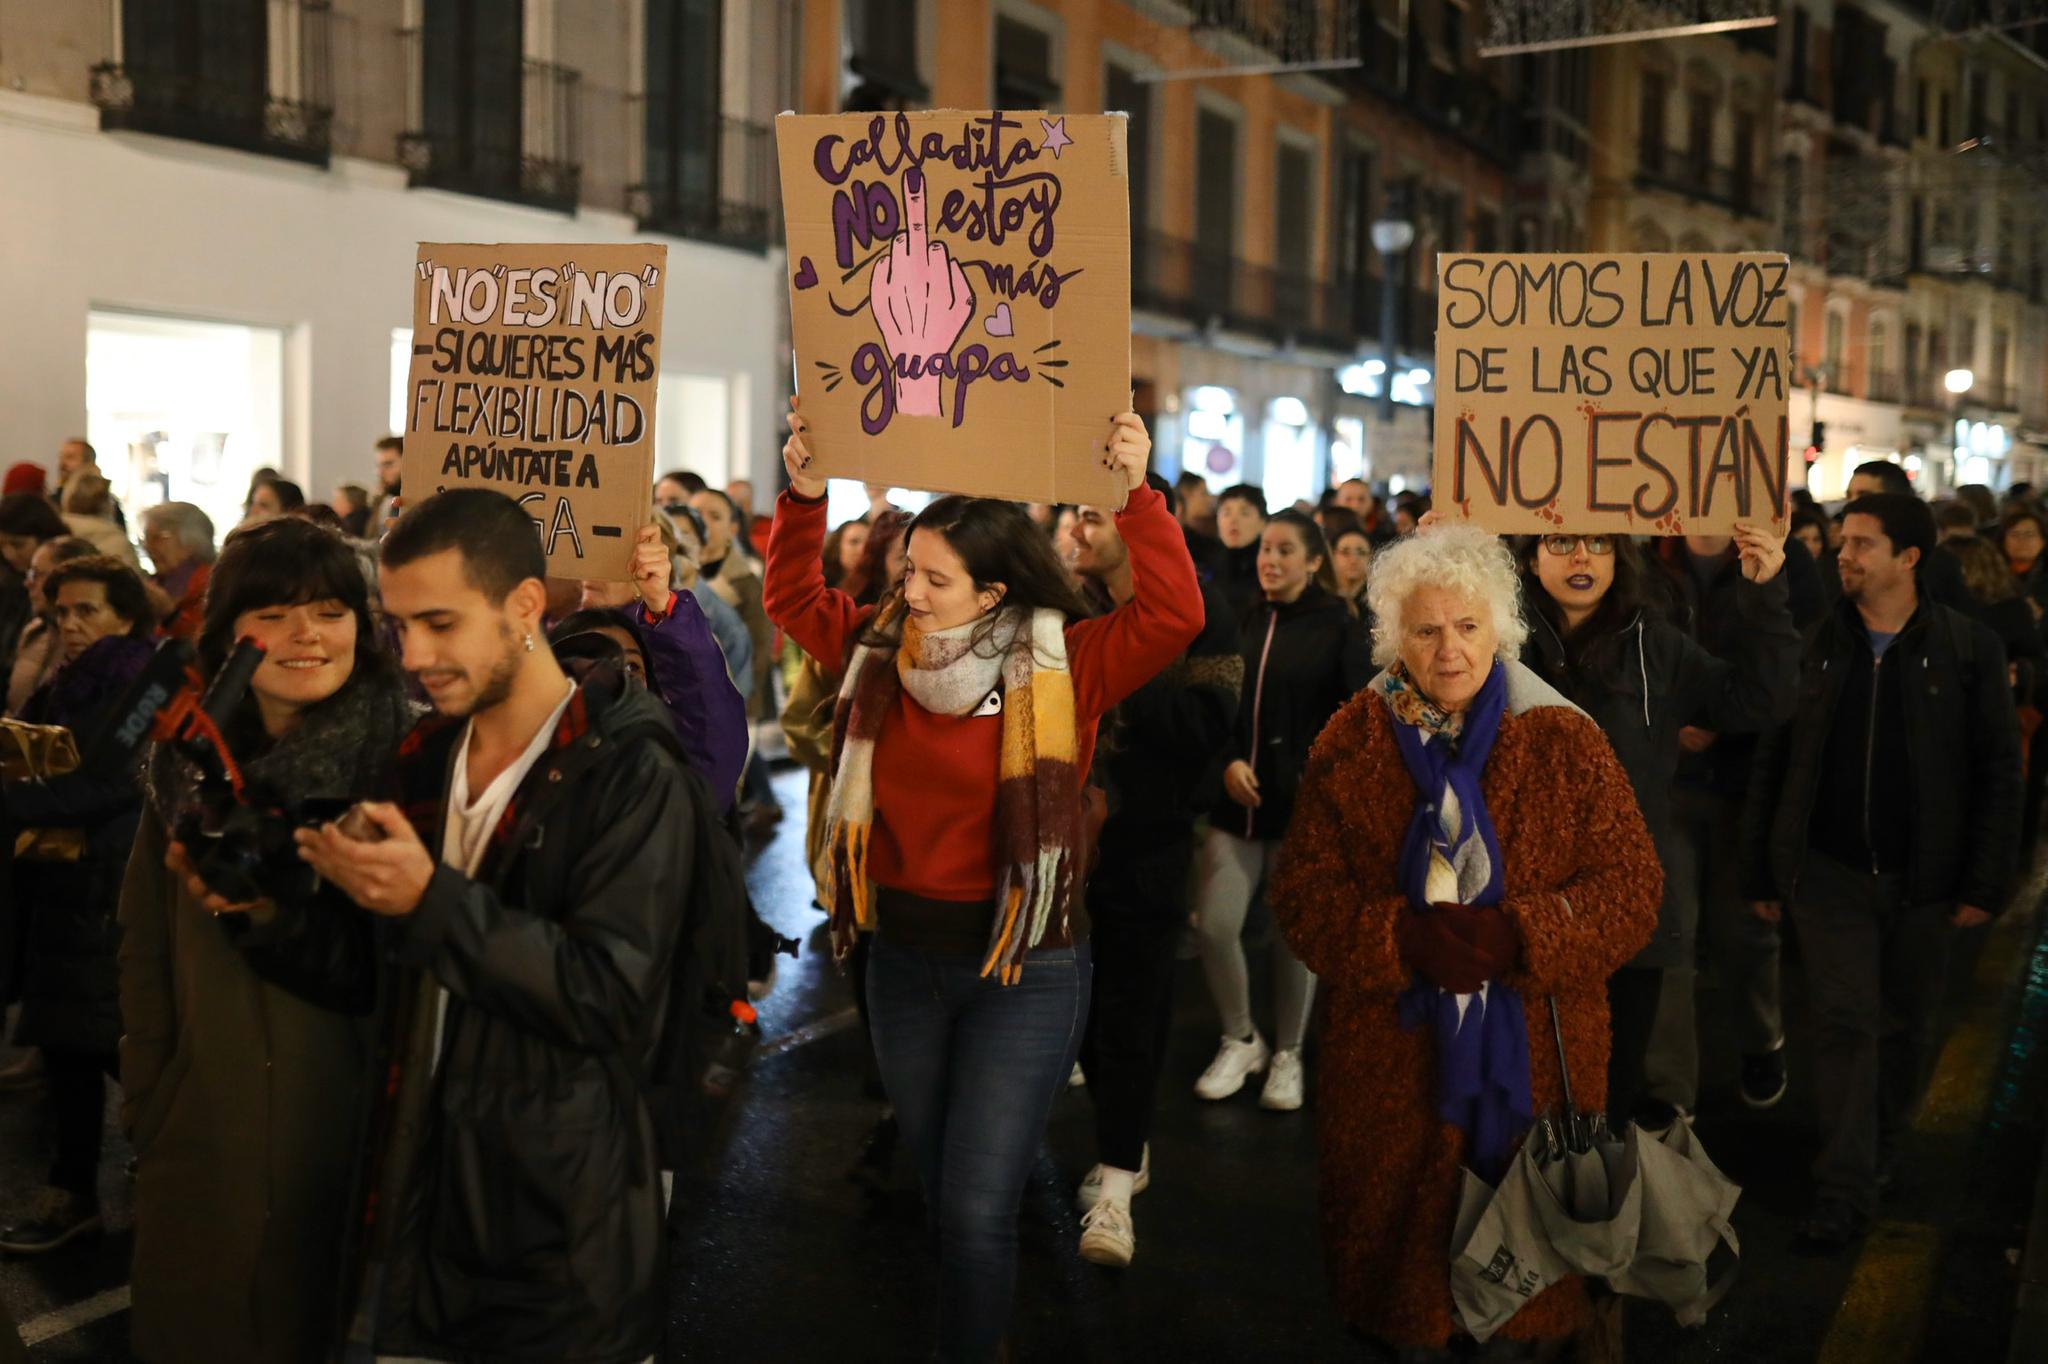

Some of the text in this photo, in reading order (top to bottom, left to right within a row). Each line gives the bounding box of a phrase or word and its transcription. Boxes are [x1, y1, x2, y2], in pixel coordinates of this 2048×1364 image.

[813, 110, 1042, 186] Calladita
[832, 171, 1062, 269] NO estoy
[502, 268, 560, 328] ES
[962, 259, 1084, 309] más
[1444, 259, 1789, 329] SOMOS LA VOZ
[466, 331, 585, 381] QUIERES
[593, 328, 655, 383] MÁS
[851, 342, 1030, 435] guapa
[1455, 345, 1783, 400] DE LAS QUE YA
[412, 379, 646, 446] FLEXIBILIDAD
[441, 441, 599, 488] APÚNTATE A
[1453, 404, 1789, 520] NO ESTÁN
